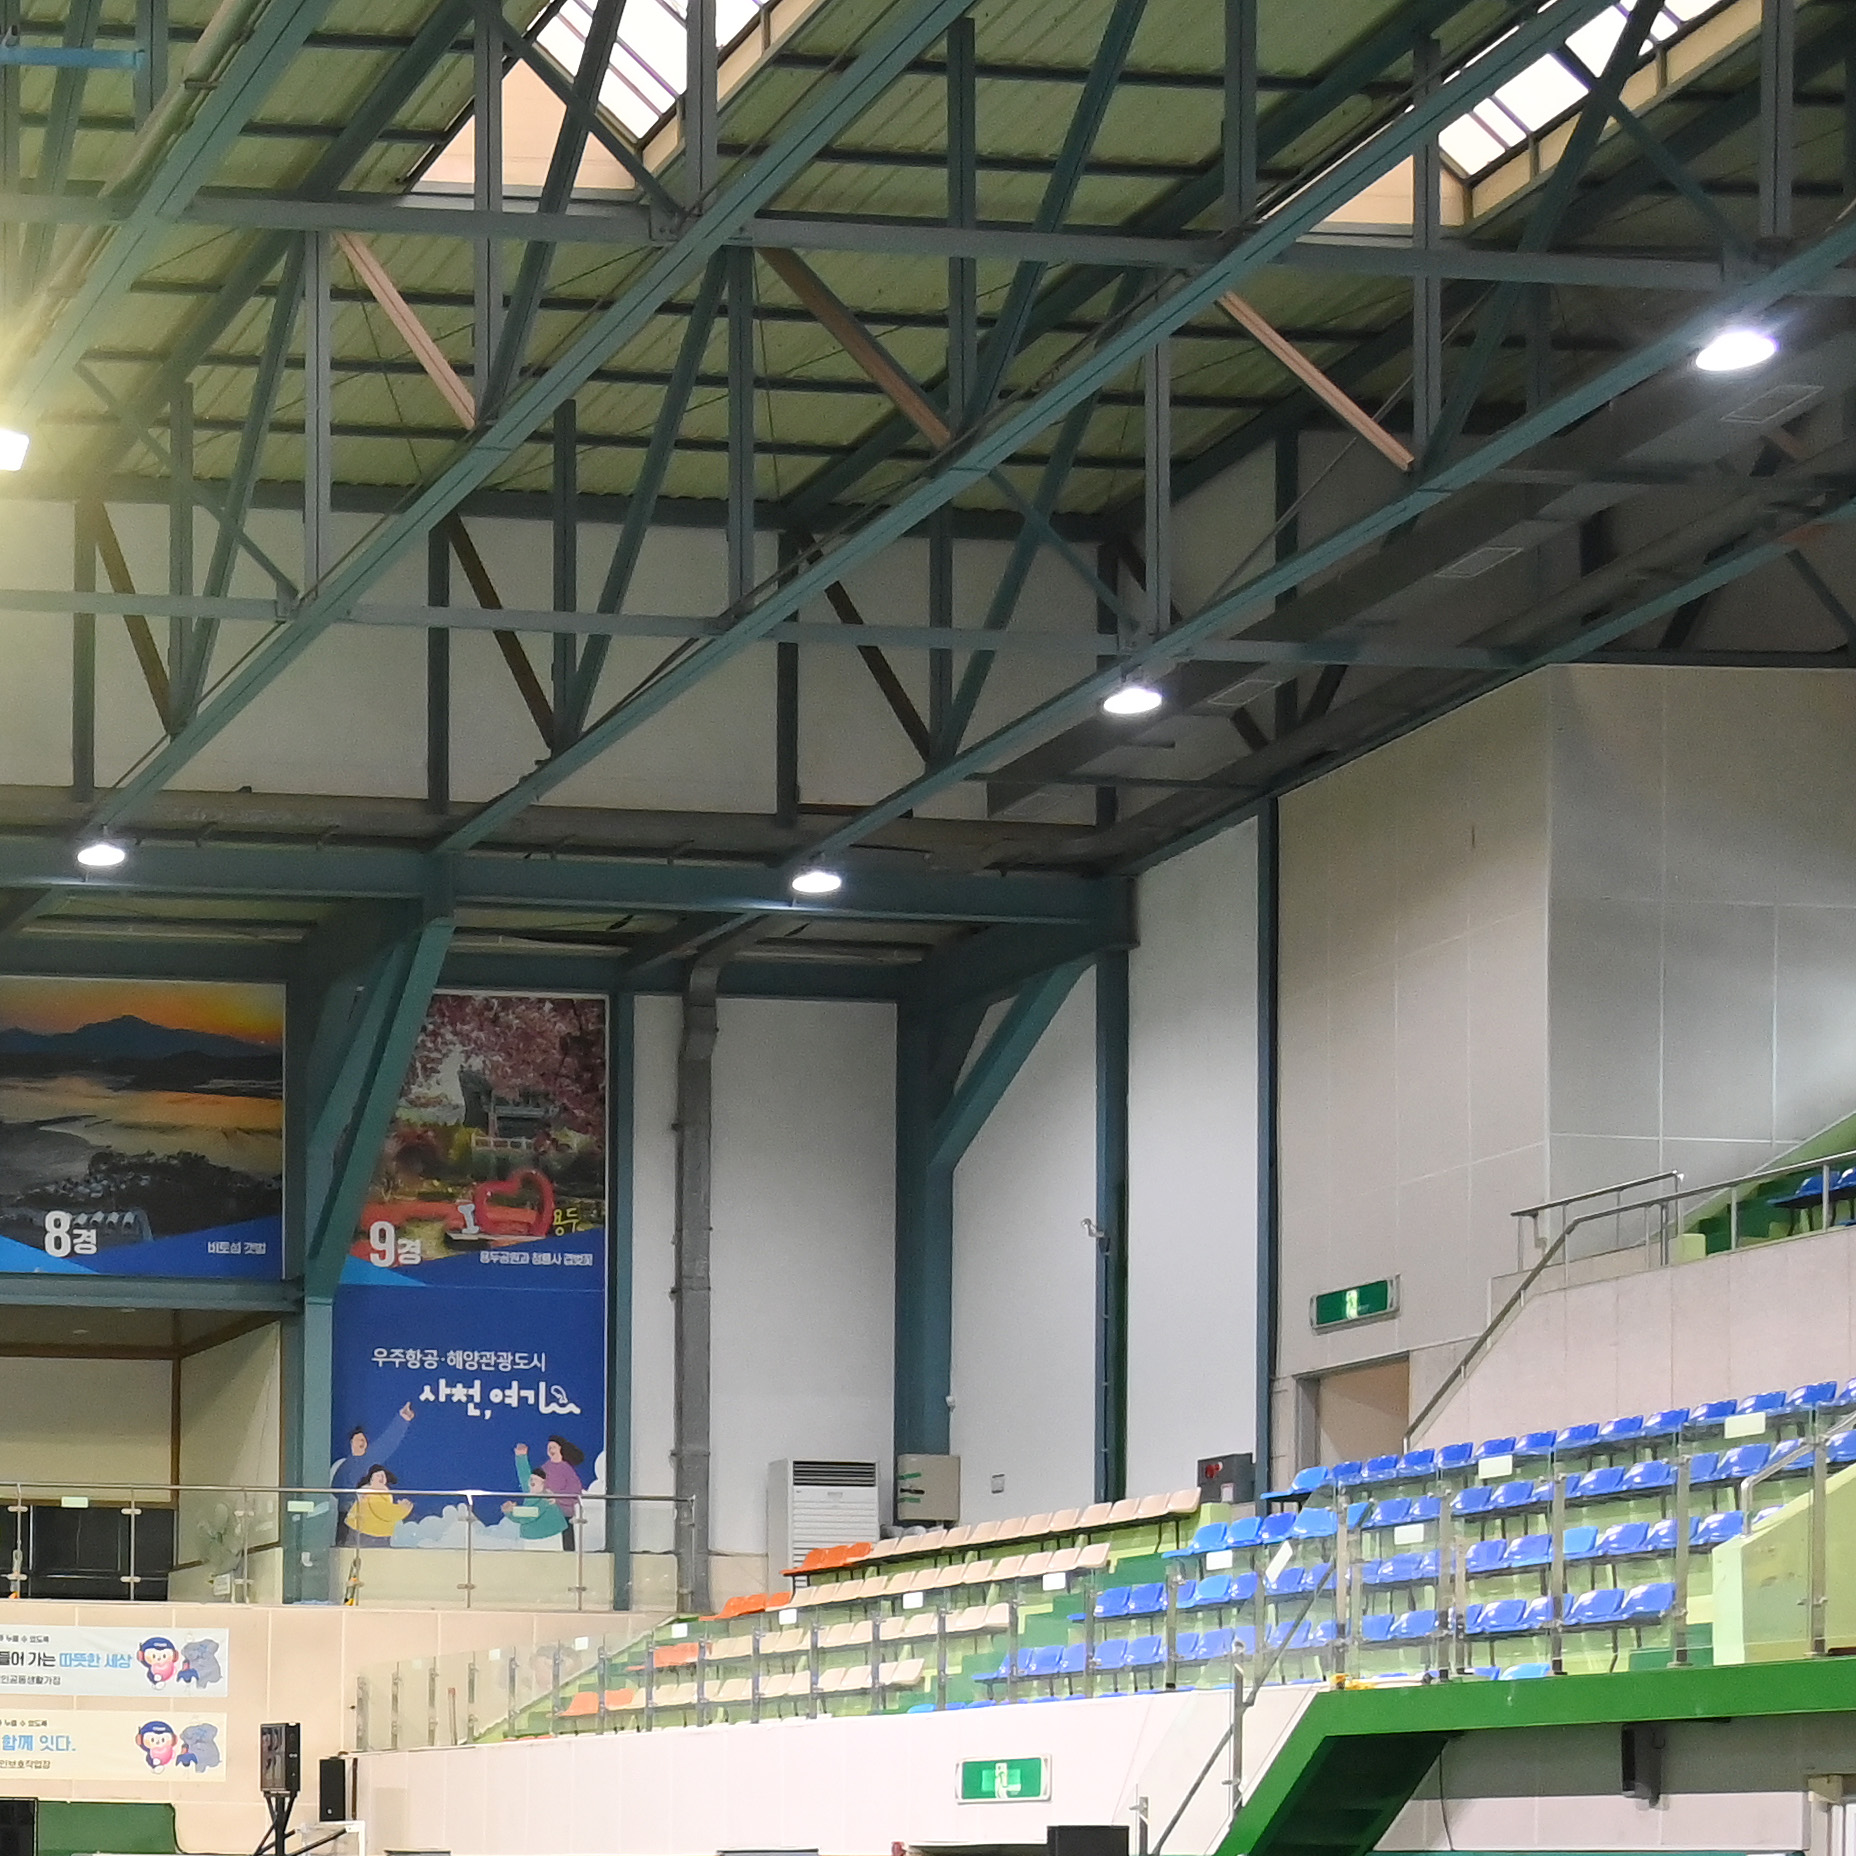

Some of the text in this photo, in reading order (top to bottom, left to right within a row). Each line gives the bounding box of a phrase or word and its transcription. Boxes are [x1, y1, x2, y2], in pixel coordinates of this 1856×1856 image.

[45, 1211, 97, 1257] 8경
[369, 1221, 422, 1267] 9경
[372, 1348, 546, 1371] 우주항공·해양관광도시
[28, 1651, 56, 1668] 가는
[60, 1652, 100, 1668] 따뜻한
[104, 1653, 131, 1669] 세상
[2, 1735, 33, 1752] 함께
[40, 1735, 76, 1752] 잇다.
